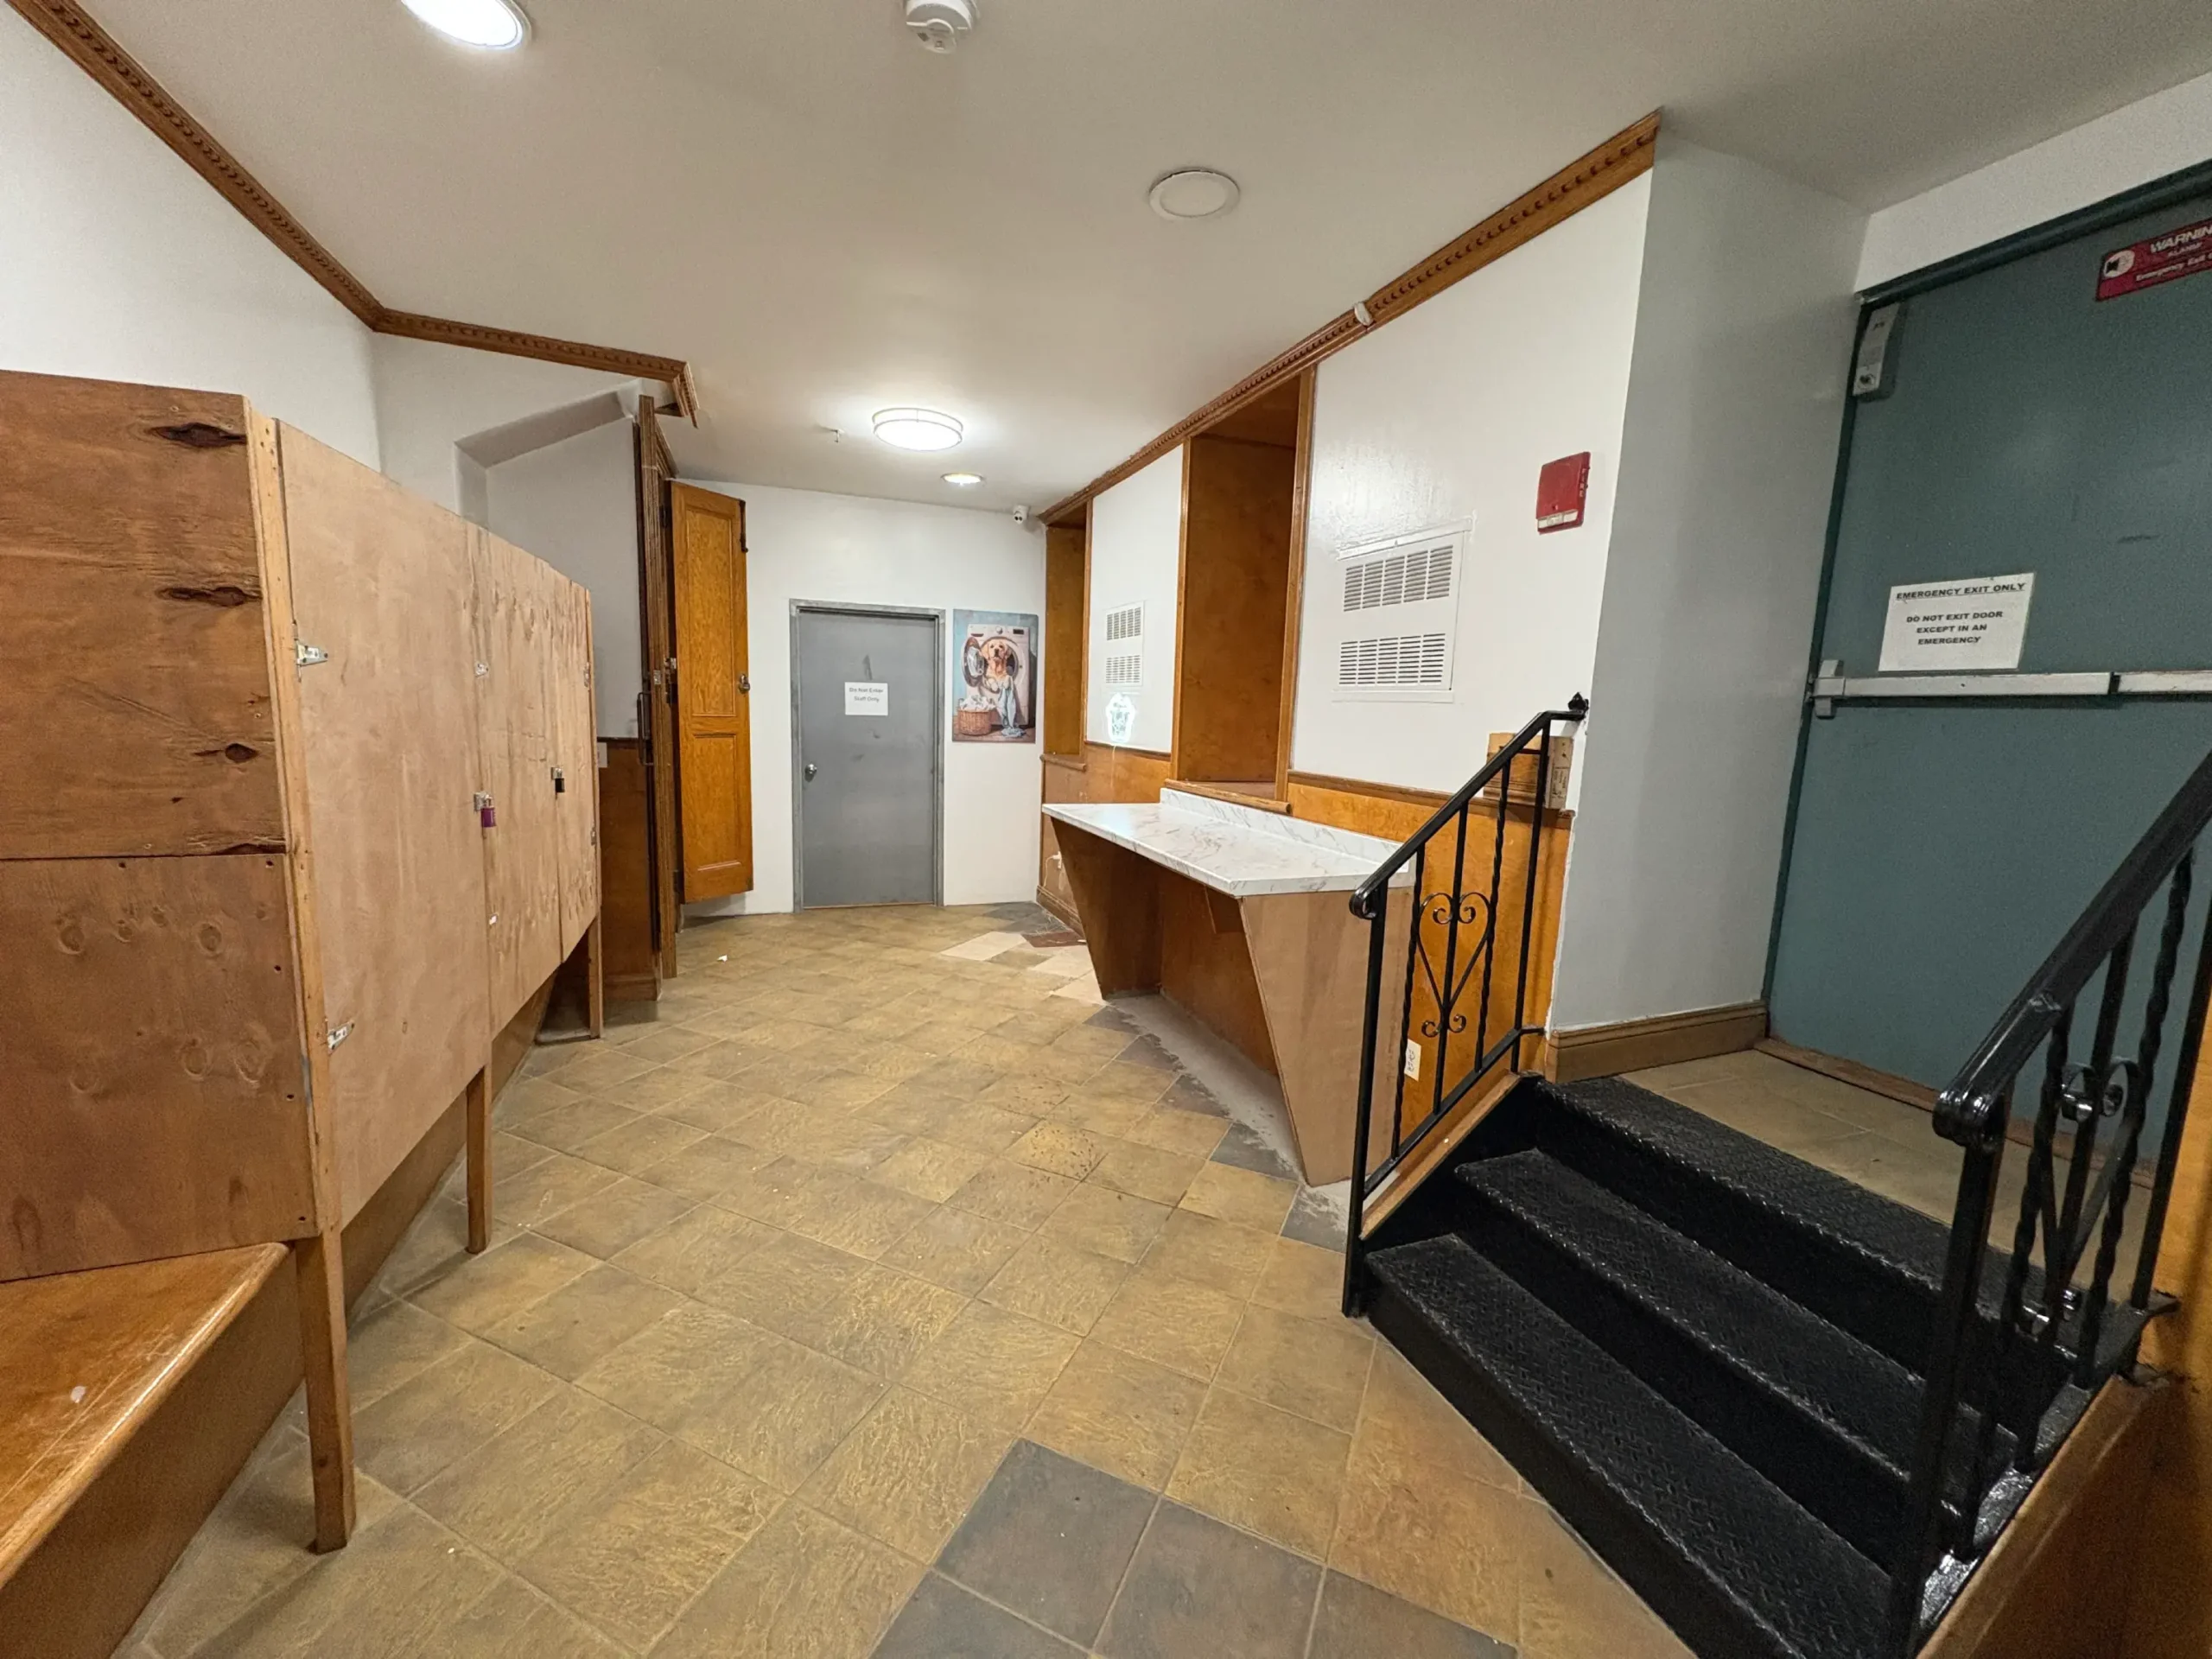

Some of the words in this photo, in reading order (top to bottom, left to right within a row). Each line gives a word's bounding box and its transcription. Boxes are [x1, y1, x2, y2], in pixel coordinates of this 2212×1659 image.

[2136, 263, 2185, 281] Emergency
[1897, 588, 1961, 600] EMERGENCY
[1993, 582, 2026, 592] ONLY
[1906, 614, 1920, 623] DO
[1917, 636, 1981, 645] EMERGENCY
